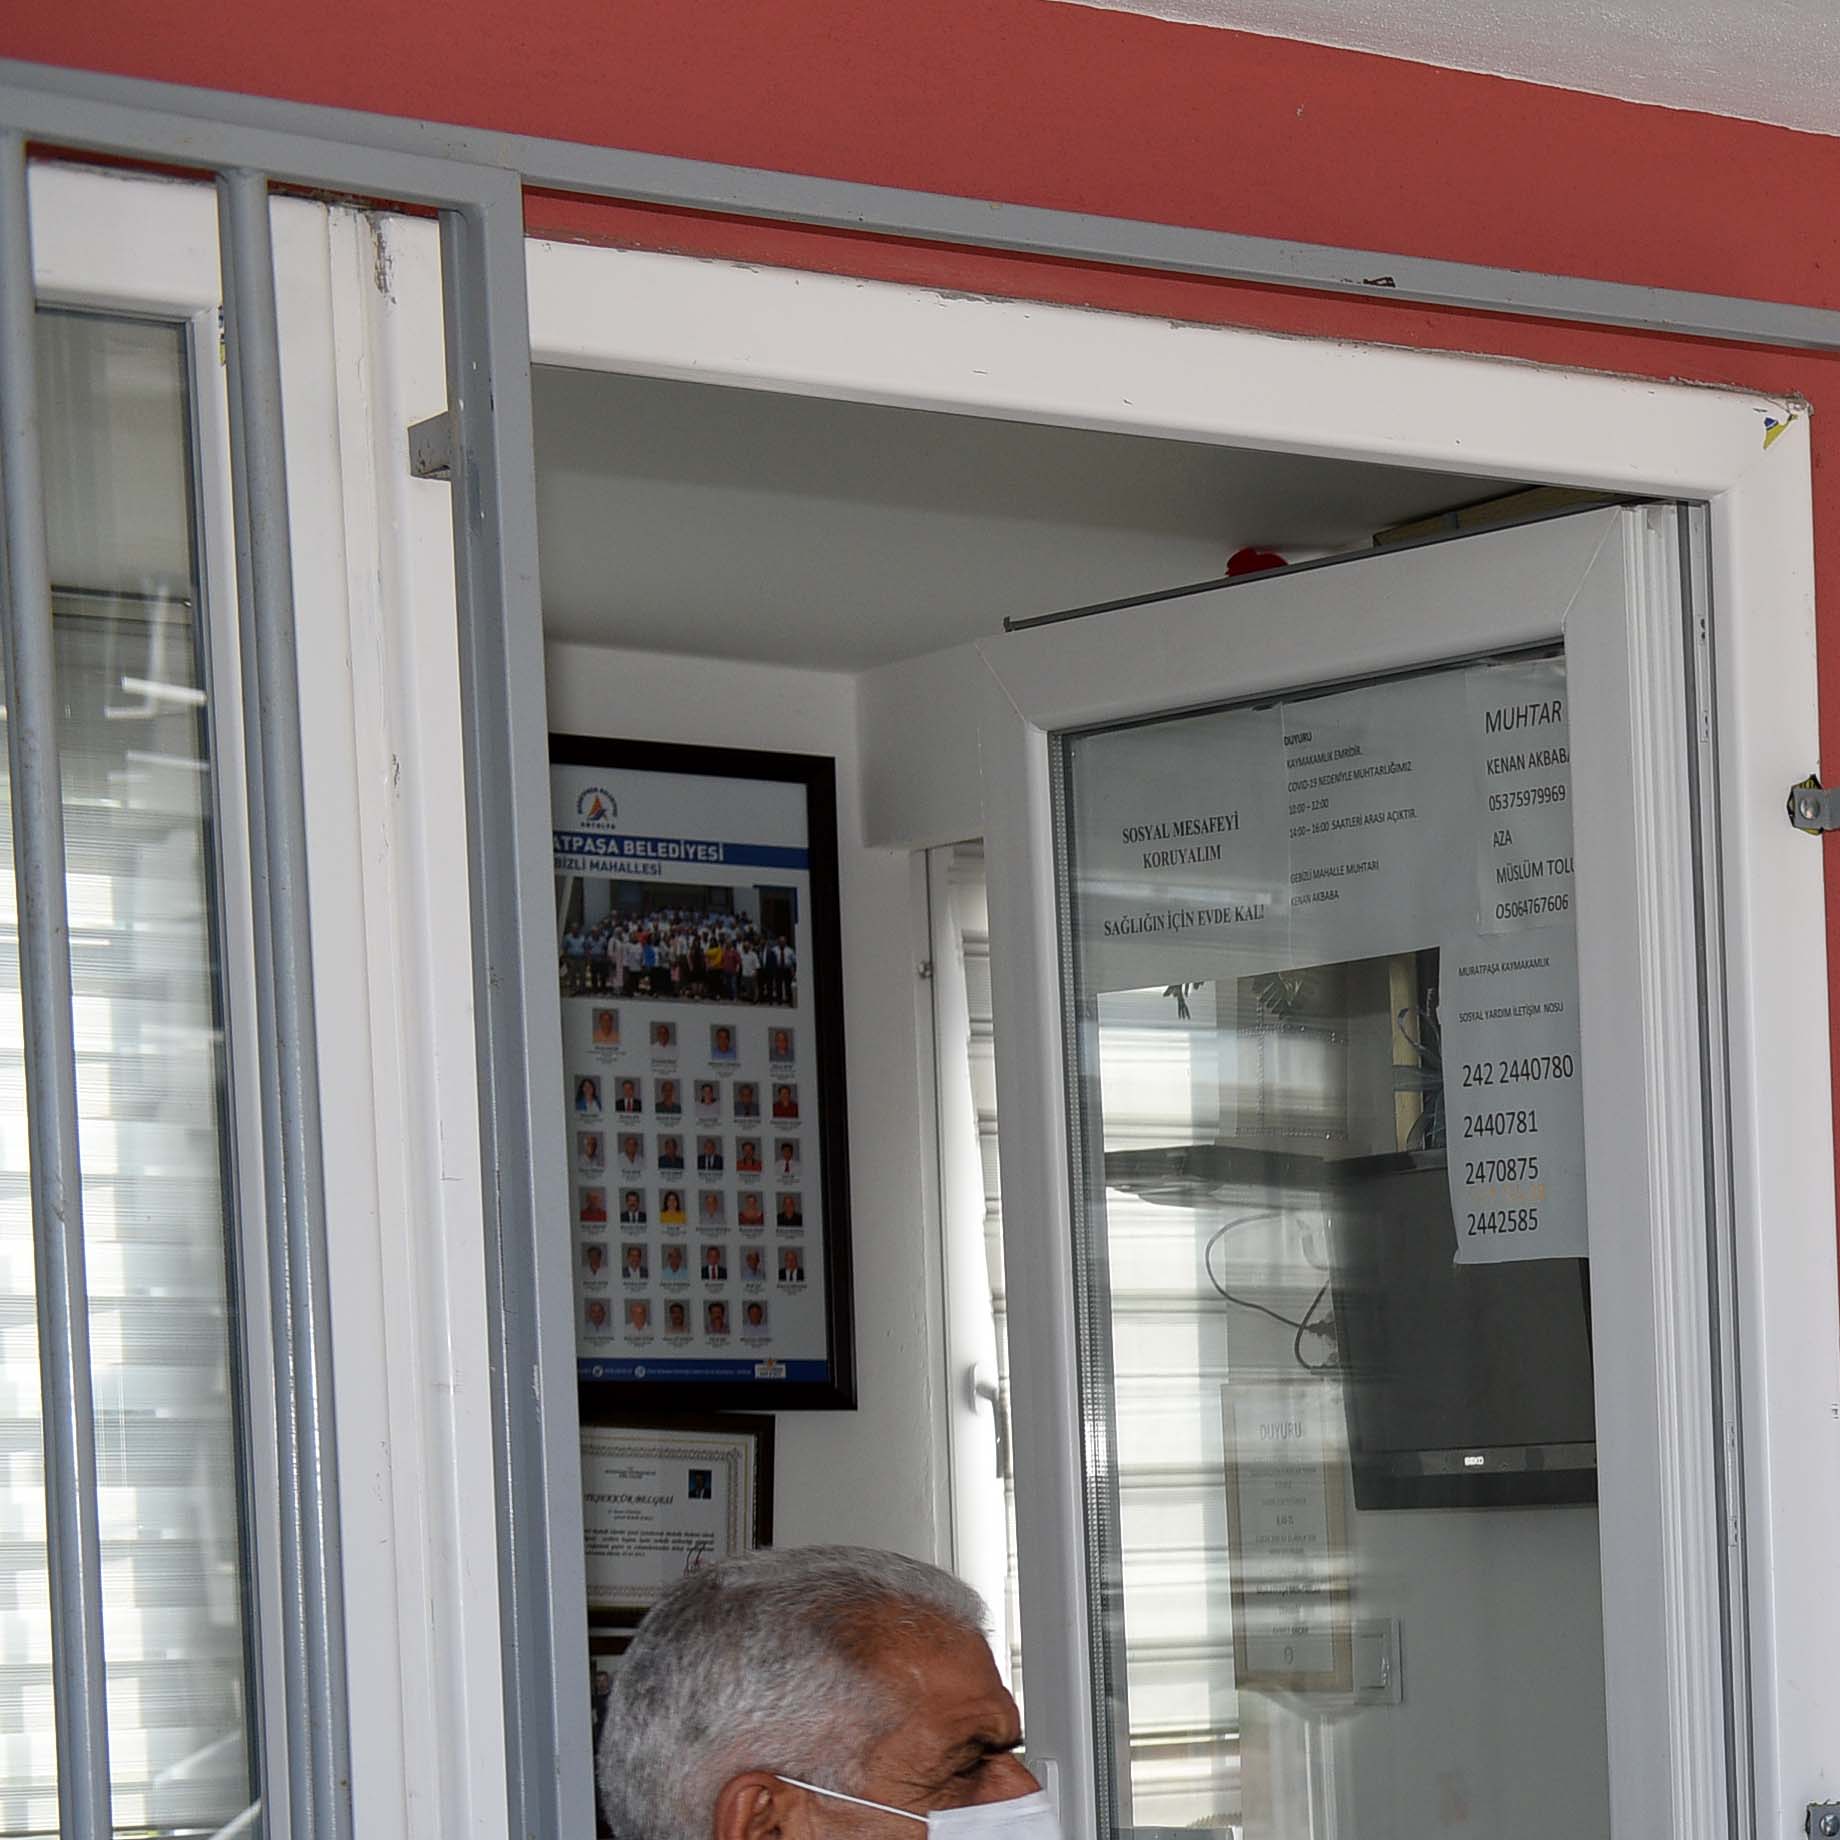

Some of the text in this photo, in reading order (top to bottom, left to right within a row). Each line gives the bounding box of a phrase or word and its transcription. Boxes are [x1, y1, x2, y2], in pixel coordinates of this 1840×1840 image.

[1485, 700, 1562, 734] MUHTAR
[1487, 753, 1526, 775] KENAN
[1488, 784, 1566, 811] 05375979969
[1122, 810, 1240, 844] SOSYAL MESAFEYİ
[1493, 829, 1513, 848] AZA
[623, 839, 724, 861] BELEDİYESİ
[1143, 844, 1221, 869] KORUYALIM
[589, 860, 662, 876] MAHALLESİ
[1496, 860, 1544, 884] MÜSLÜM
[1104, 904, 1265, 936] SAĞLIĞIN İÇİN EVDE KAL!
[1462, 1054, 1574, 1087] 242 2440780
[1463, 1110, 1538, 1138] 2440781
[1465, 1157, 1539, 1185] 2470875
[1467, 1208, 1538, 1236] 2442585
[1259, 1422, 1303, 1441] DUYURU
